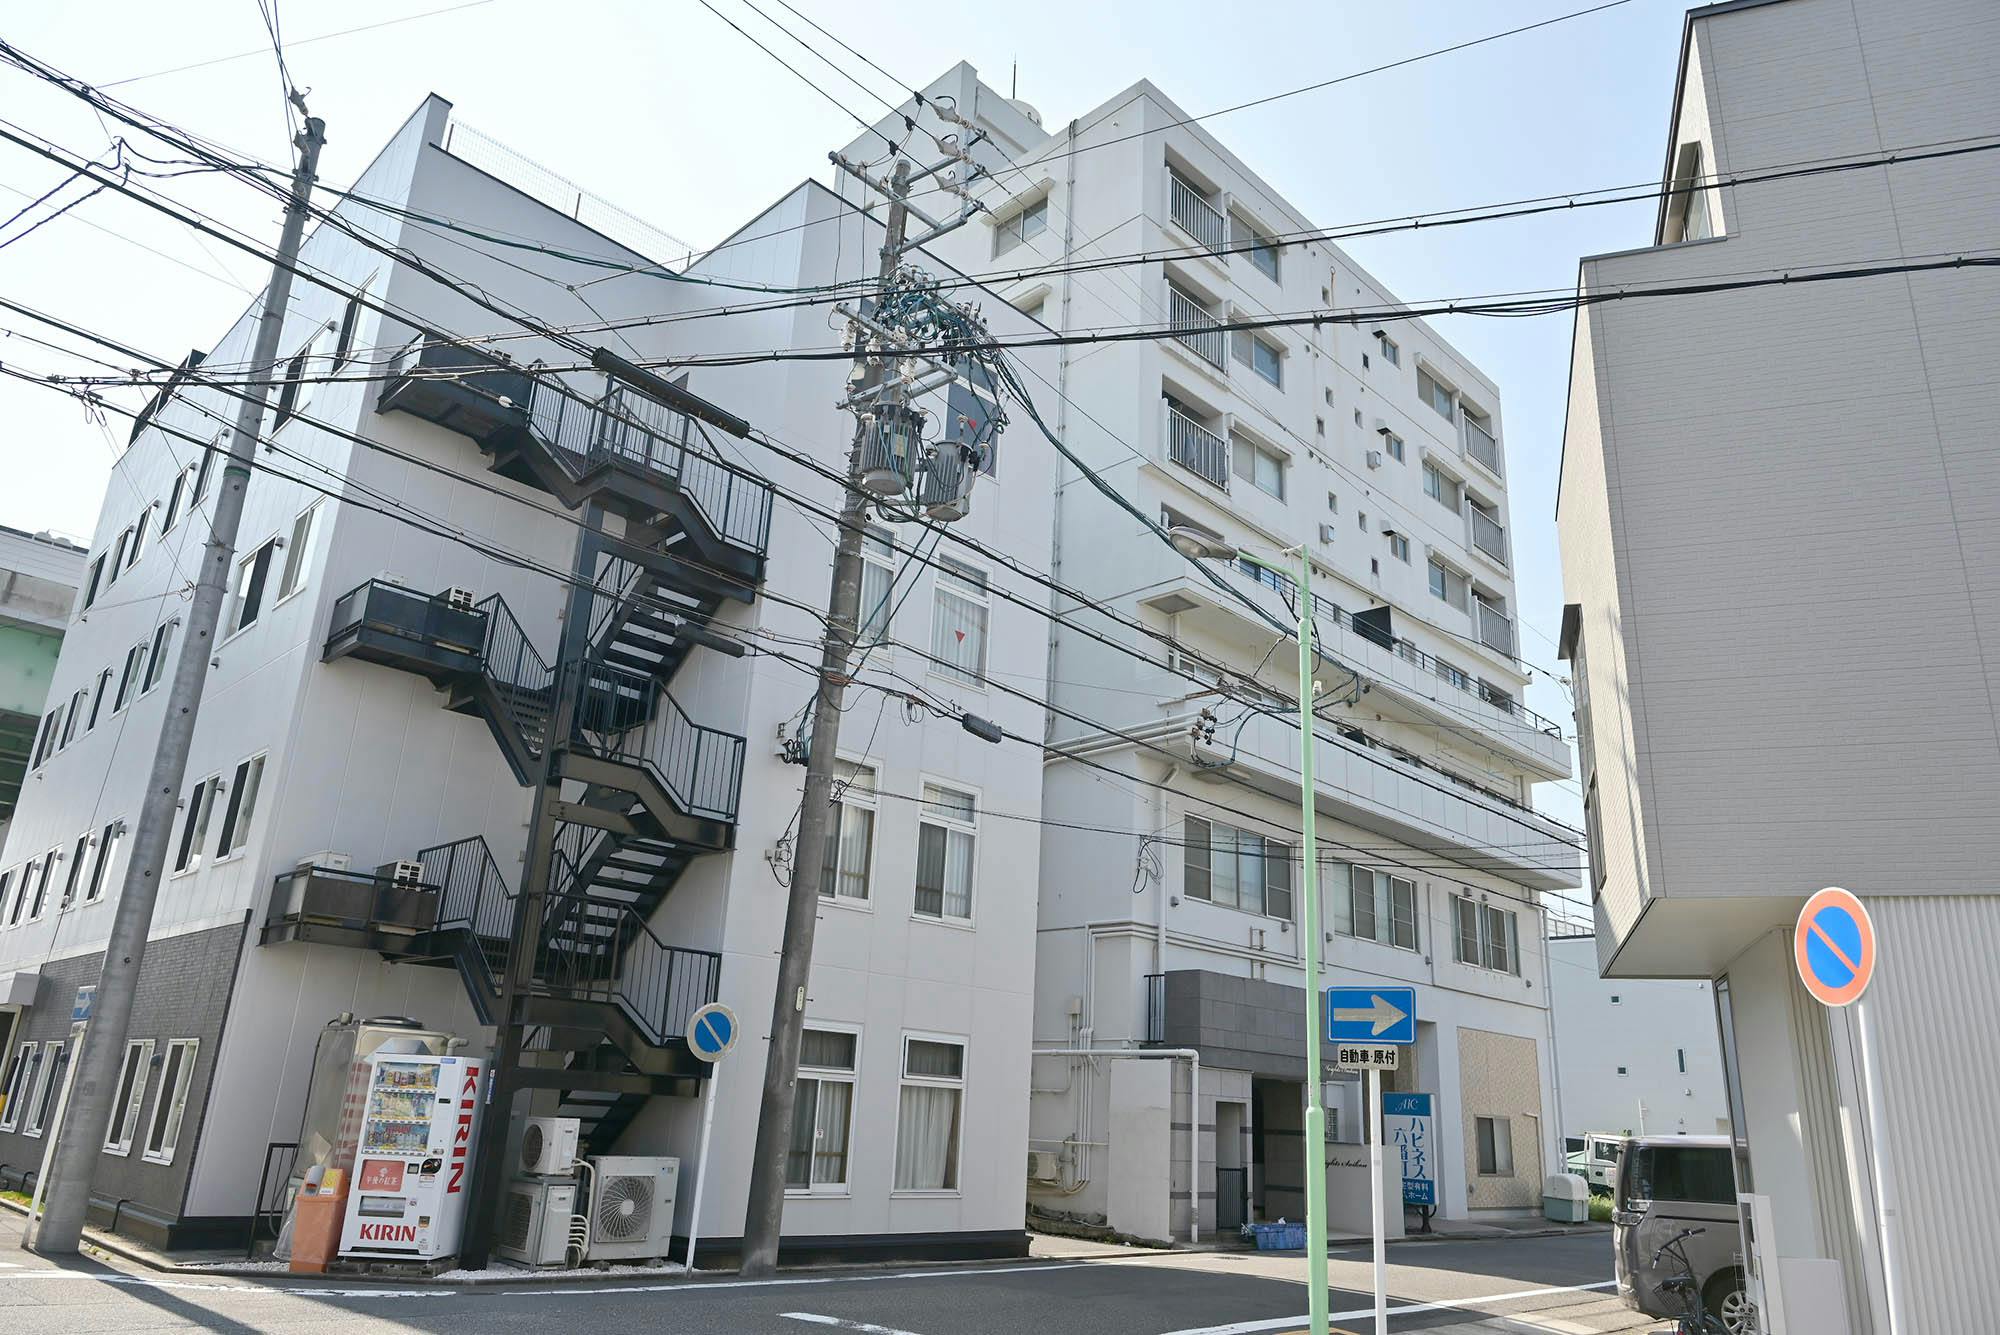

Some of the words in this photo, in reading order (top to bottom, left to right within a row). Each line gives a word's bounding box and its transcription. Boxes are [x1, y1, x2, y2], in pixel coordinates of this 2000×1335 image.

[1340, 1048, 1396, 1065] 自動車・原付
[447, 1067, 479, 1193] KIRIN
[360, 1223, 416, 1242] KIRIN
